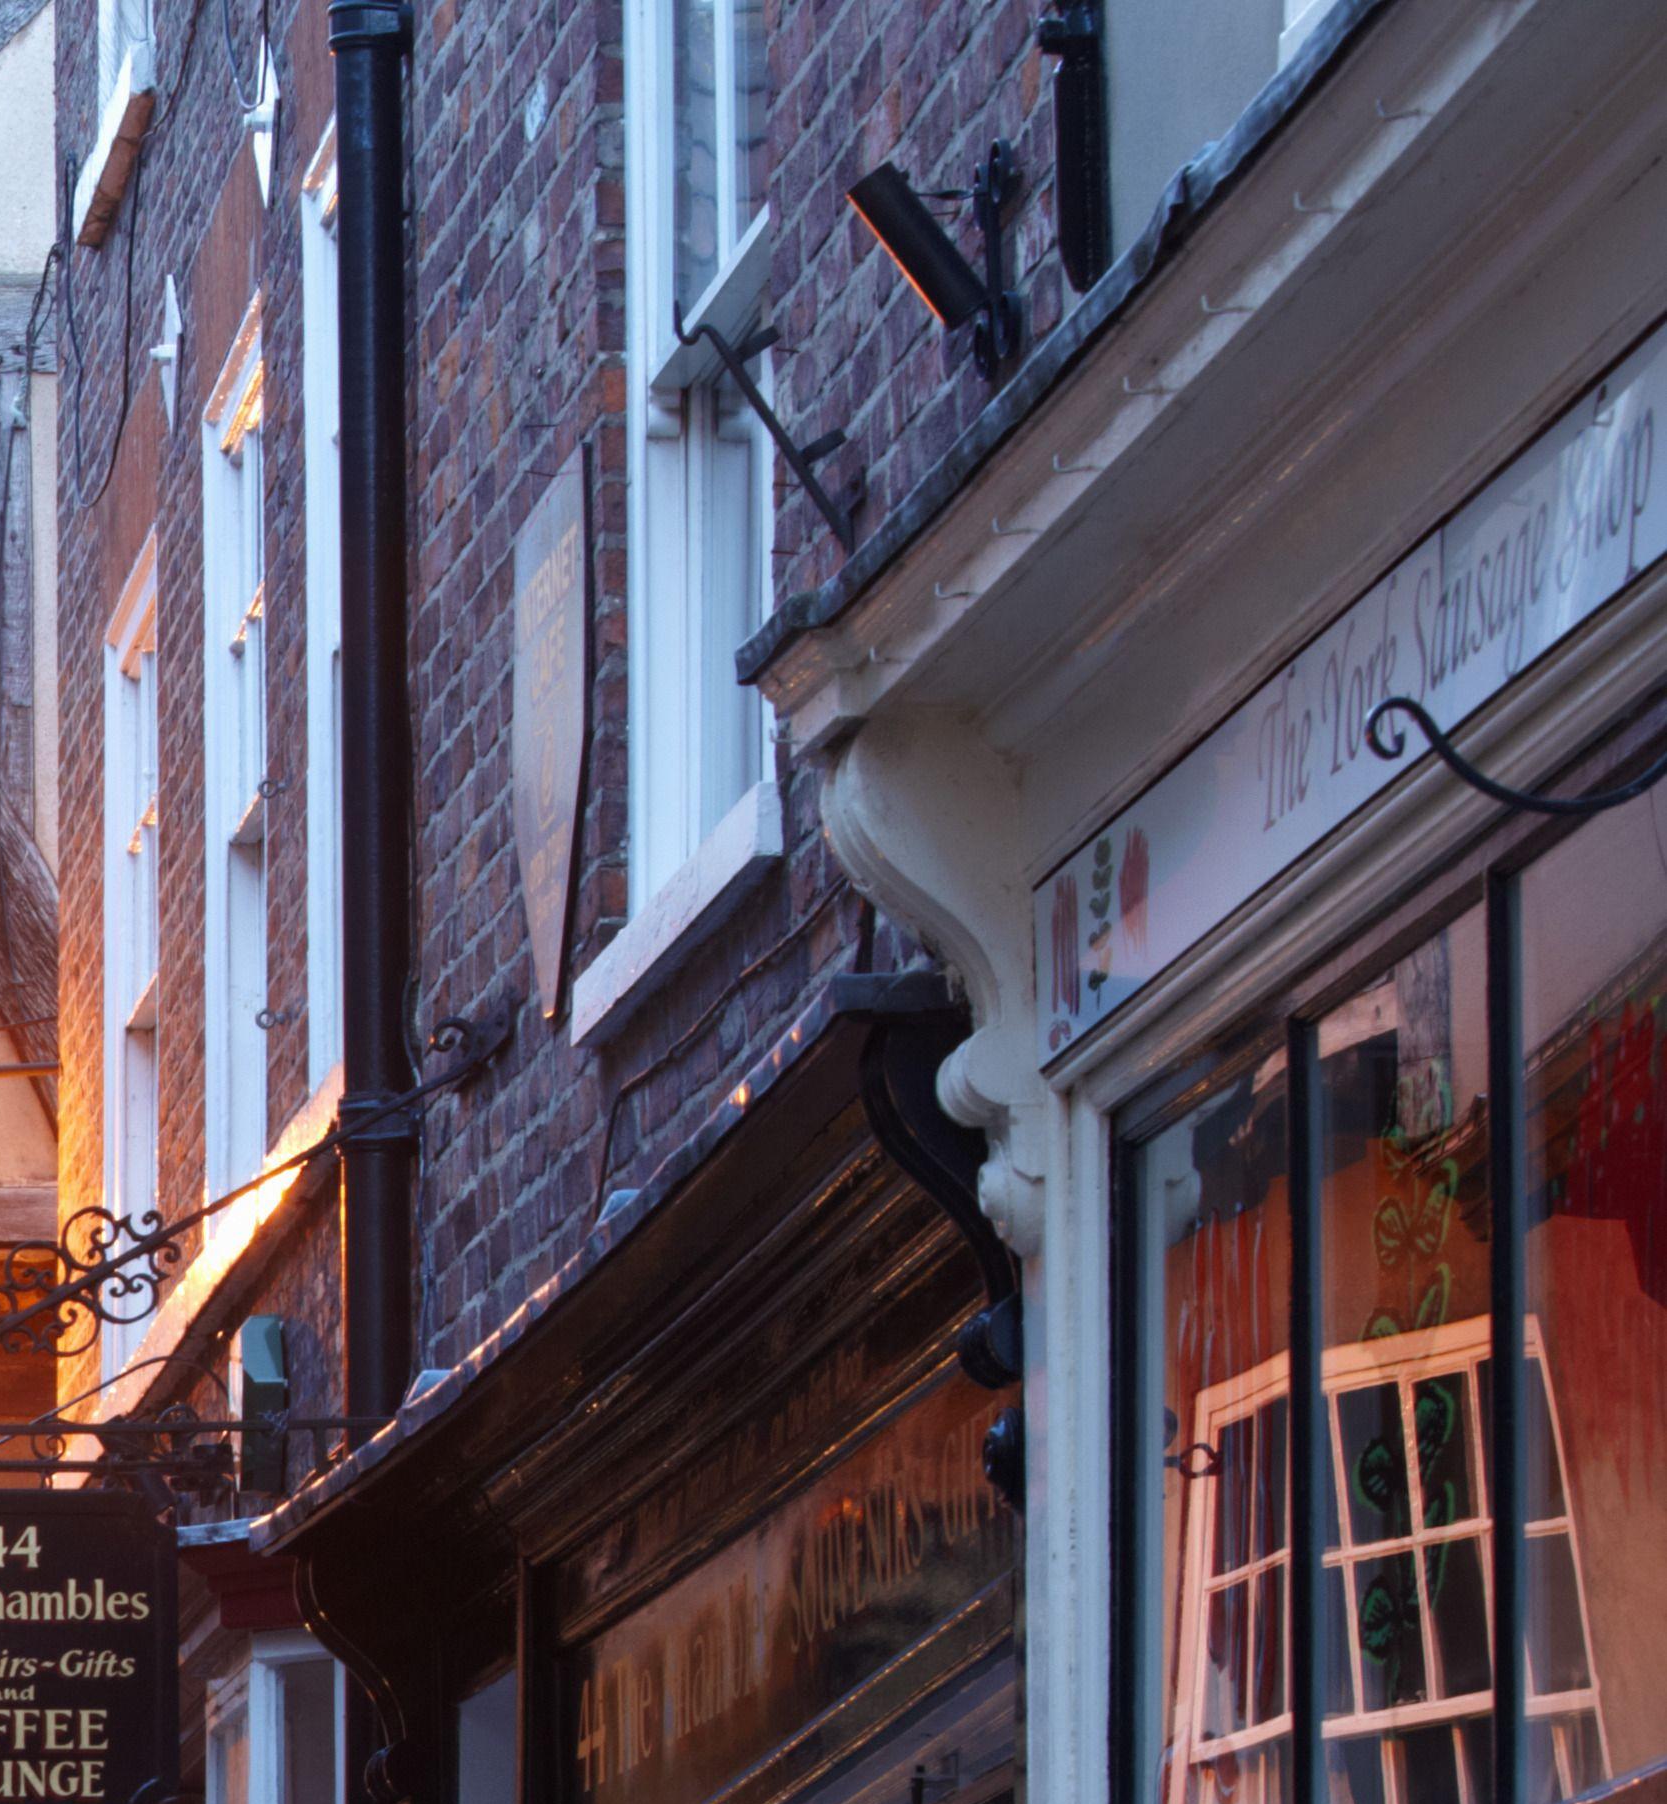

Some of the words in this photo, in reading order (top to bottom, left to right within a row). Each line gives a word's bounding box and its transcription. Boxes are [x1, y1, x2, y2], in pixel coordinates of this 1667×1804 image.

[1258, 666, 1311, 831] The
[1321, 574, 1405, 775] York
[1408, 502, 1548, 702] Sausage
[1557, 405, 1655, 593] Shop
